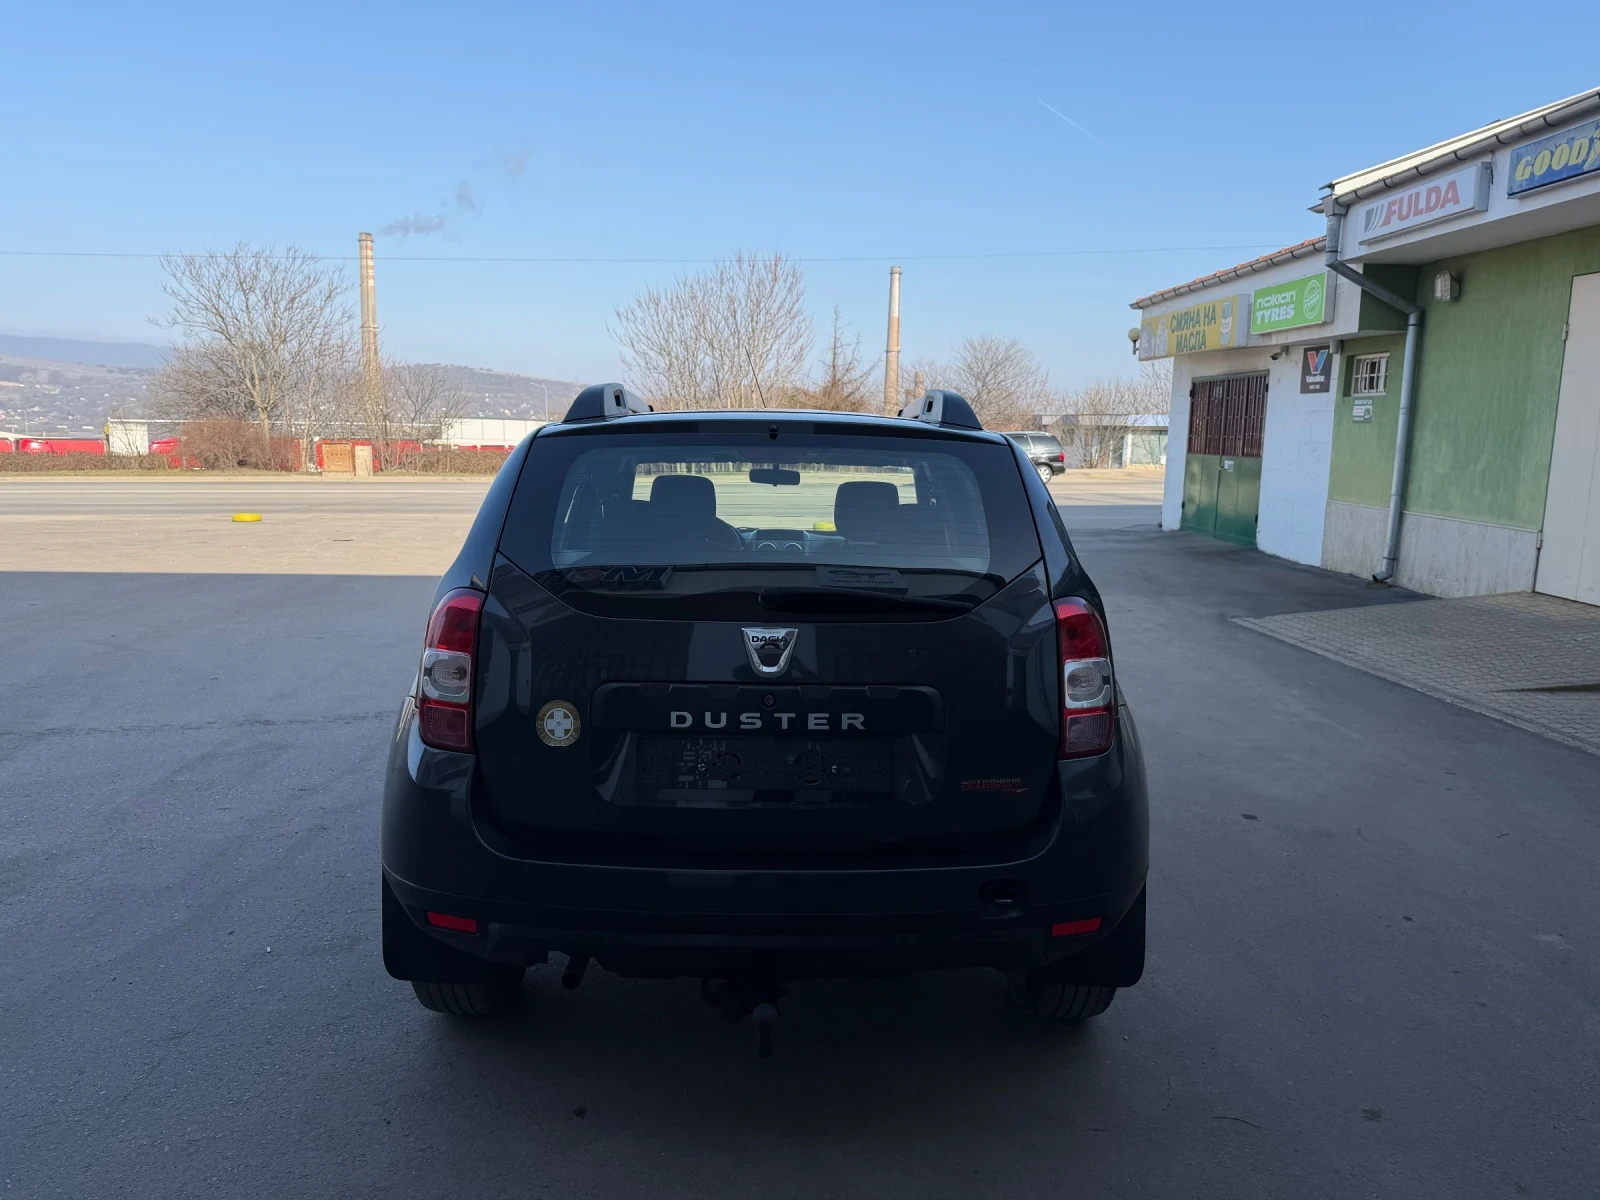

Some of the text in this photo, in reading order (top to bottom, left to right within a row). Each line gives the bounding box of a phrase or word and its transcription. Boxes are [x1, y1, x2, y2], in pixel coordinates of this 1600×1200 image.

[1379, 179, 1460, 228] FULDA
[1170, 304, 1217, 334] СМЯНА НА
[1256, 303, 1295, 325] TYRES
[1176, 329, 1207, 353] МАСЛА
[751, 635, 788, 643] DACIA
[669, 711, 867, 731] DUSTER
